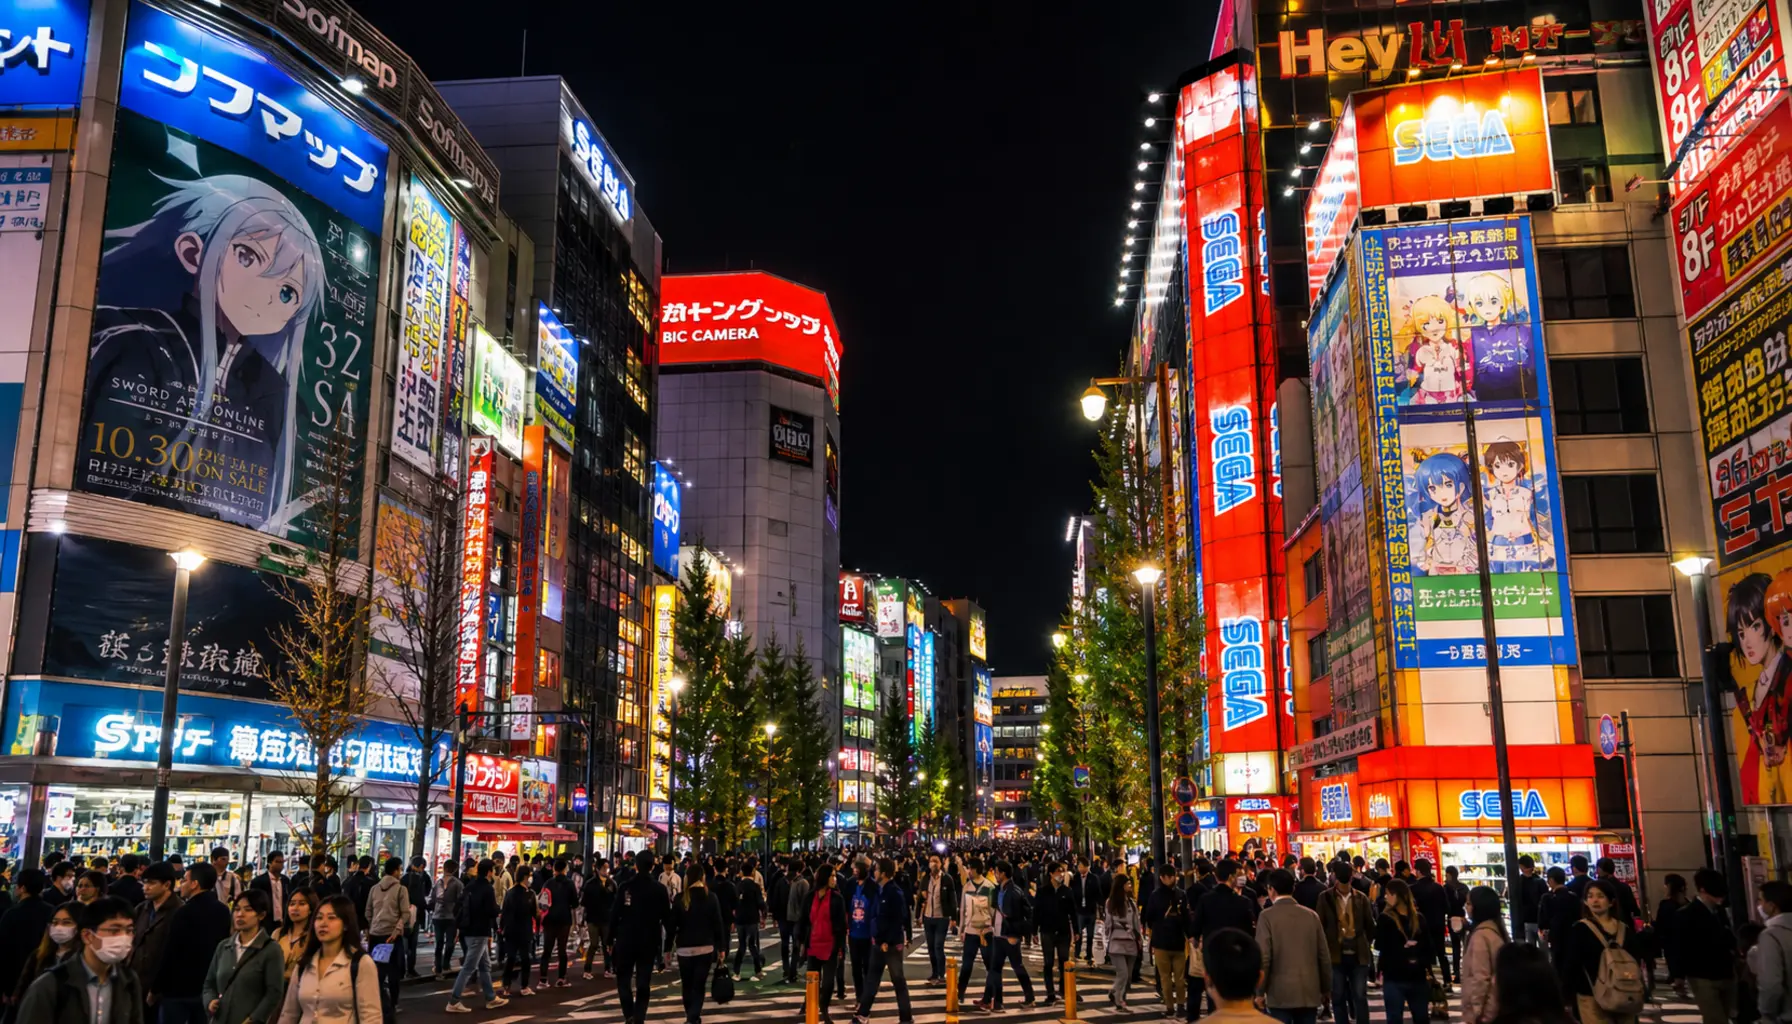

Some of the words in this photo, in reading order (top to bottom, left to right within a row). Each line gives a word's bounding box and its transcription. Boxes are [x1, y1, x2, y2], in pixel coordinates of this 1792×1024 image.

[1278, 28, 1404, 82] Hey
[1664, 40, 1695, 97] 8F
[1393, 109, 1516, 167] SEGA
[1671, 84, 1701, 145] 8F
[1201, 210, 1245, 318] SEGA
[1682, 222, 1715, 282] 8F
[662, 330, 688, 344] BIC
[692, 327, 759, 342] CAMERA
[111, 377, 170, 401] SWORD
[213, 405, 265, 431] ONLINE
[90, 422, 194, 472] 10.30
[1210, 405, 1256, 517] SEGA
[195, 462, 223, 482] ON
[228, 469, 267, 495] SALE
[1220, 615, 1268, 732] SEGA
[1321, 782, 1352, 822] SEGA
[1459, 789, 1551, 820] SEGA
